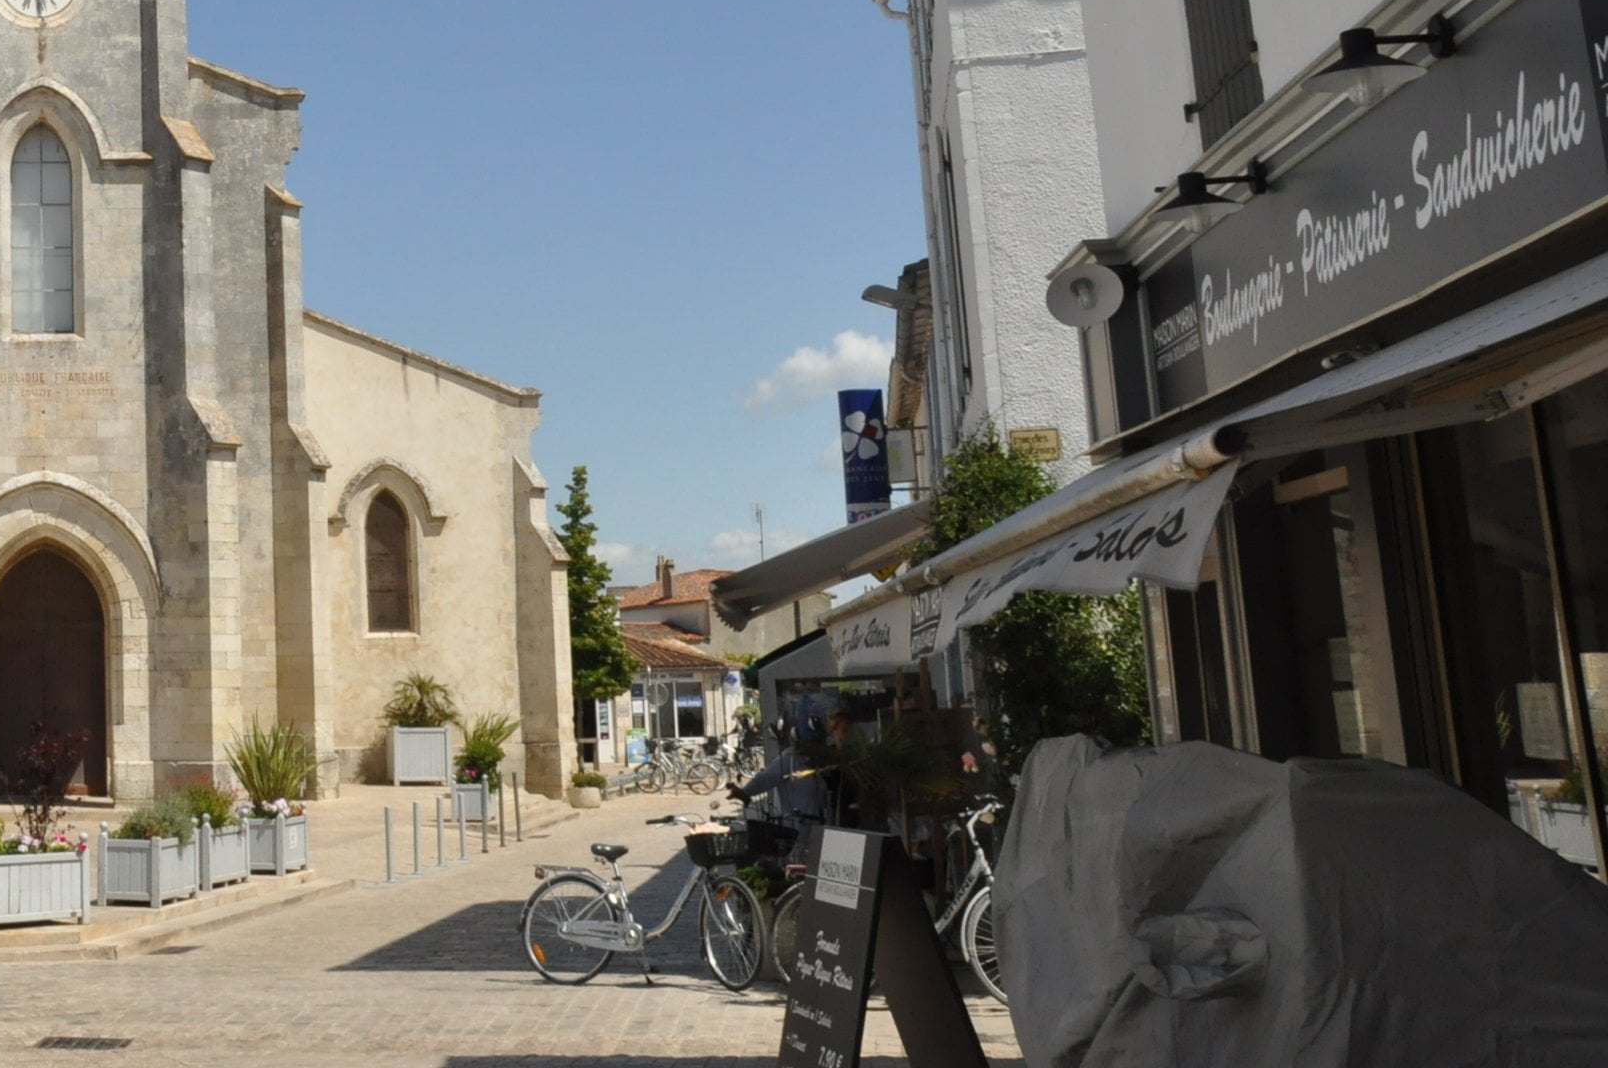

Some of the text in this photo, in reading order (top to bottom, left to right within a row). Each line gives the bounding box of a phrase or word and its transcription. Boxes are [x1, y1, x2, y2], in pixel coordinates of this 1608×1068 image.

[1200, 255, 1284, 346] Boulangerie
[1296, 190, 1390, 297] Pâtisserie
[1411, 70, 1586, 230] Sandwicherie
